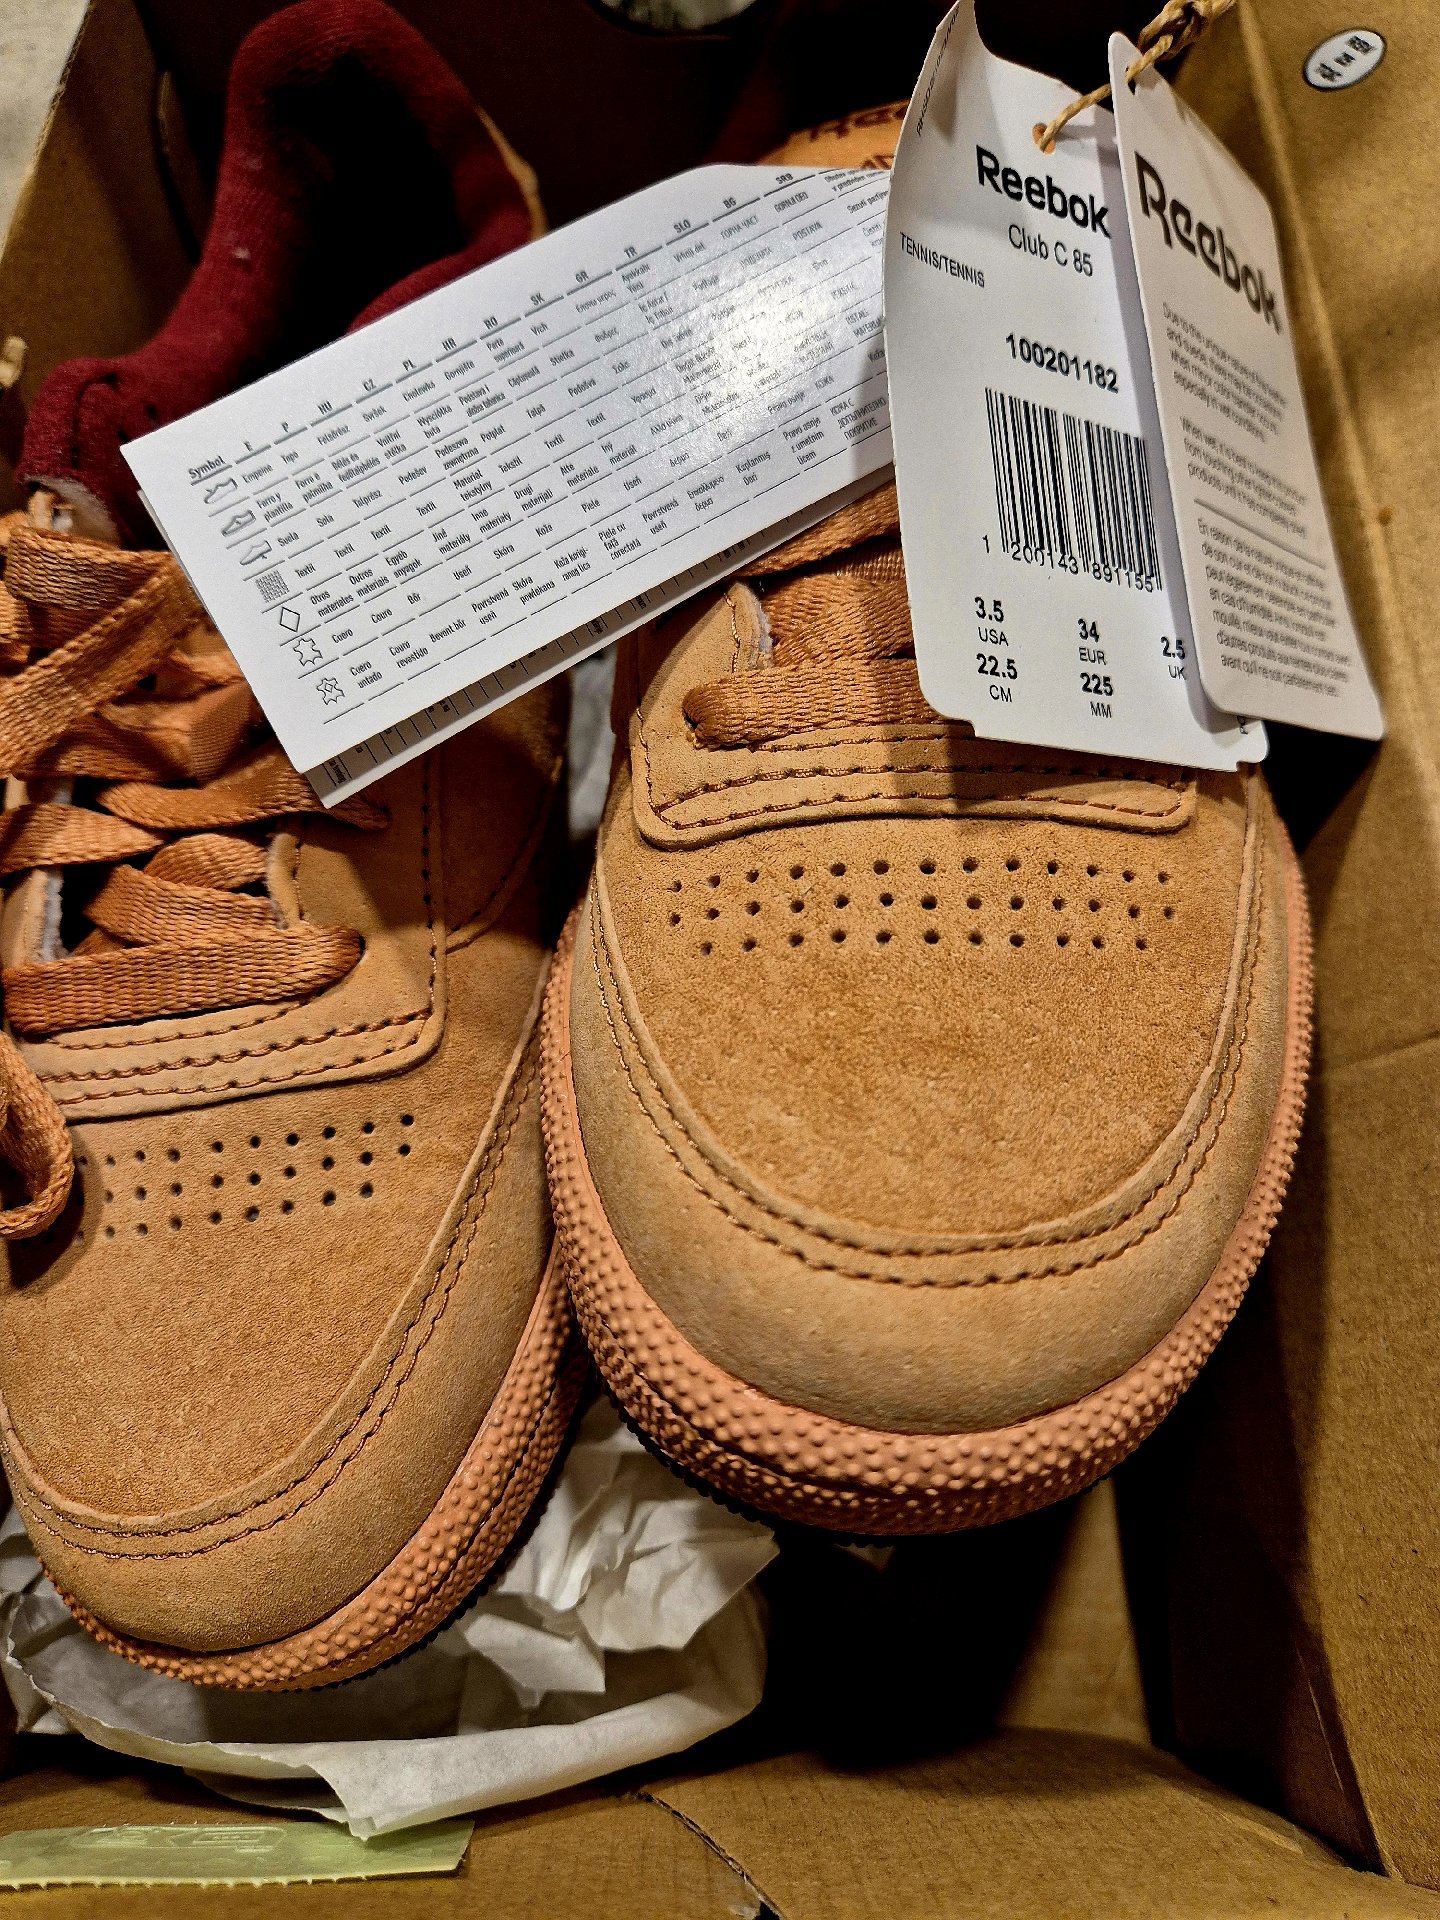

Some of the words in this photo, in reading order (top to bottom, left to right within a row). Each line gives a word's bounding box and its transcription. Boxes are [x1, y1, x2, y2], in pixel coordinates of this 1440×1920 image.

[776, 173, 793, 184] SRB
[976, 145, 1112, 239] Reebok
[723, 197, 736, 208] BG
[674, 219, 691, 233] SLO
[1008, 224, 1049, 260] Club
[1054, 241, 1068, 267] C
[1072, 249, 1093, 277] 85
[1134, 151, 1282, 335] Reebok
[624, 246, 637, 258] TR
[900, 232, 985, 288] TENNIS/TENNIS
[576, 271, 589, 283] GR
[530, 293, 545, 305] SK
[484, 317, 498, 329] RO
[531, 324, 548, 335] Vrch
[442, 338, 456, 351] HR
[403, 360, 416, 371] PL
[1005, 332, 1119, 394] 100201182
[363, 379, 376, 391] CZ
[318, 401, 332, 414] HU
[280, 421, 291, 433] P
[586, 413, 606, 427] Textil
[243, 440, 253, 452] E
[544, 434, 564, 449] Textil
[189, 456, 225, 478] Symbol
[498, 456, 522, 473] Tekstil
[417, 501, 436, 516] Textil
[581, 500, 600, 512] Piele
[317, 515, 334, 527] Sola
[278, 532, 299, 546] Suela
[371, 525, 391, 540] Textil
[599, 528, 616, 541] Piele
[615, 522, 626, 533] cu
[334, 543, 355, 558] Textil
[295, 563, 316, 578] Textil
[982, 535, 990, 553] 1
[1011, 541, 1079, 575] 200143
[1092, 562, 1154, 593] 891155
[350, 570, 373, 584] Outros
[311, 592, 330, 604] Otros
[318, 595, 354, 617] materiales
[974, 596, 1004, 623] 3.5
[372, 609, 392, 623] Couro
[332, 629, 353, 643] Cuero
[978, 626, 1009, 646] USA
[1077, 618, 1100, 643] 34
[389, 642, 410, 656] Couro
[1160, 636, 1186, 660] 2.5
[397, 648, 428, 668] revestido
[1079, 647, 1107, 666] EUR
[350, 662, 371, 676] Cuero
[976, 653, 1018, 680] 22.5
[1168, 665, 1187, 680] UK
[358, 672, 382, 688] untado
[1080, 672, 1114, 696] 225
[989, 685, 1013, 702] CM
[1090, 701, 1112, 718] MM
